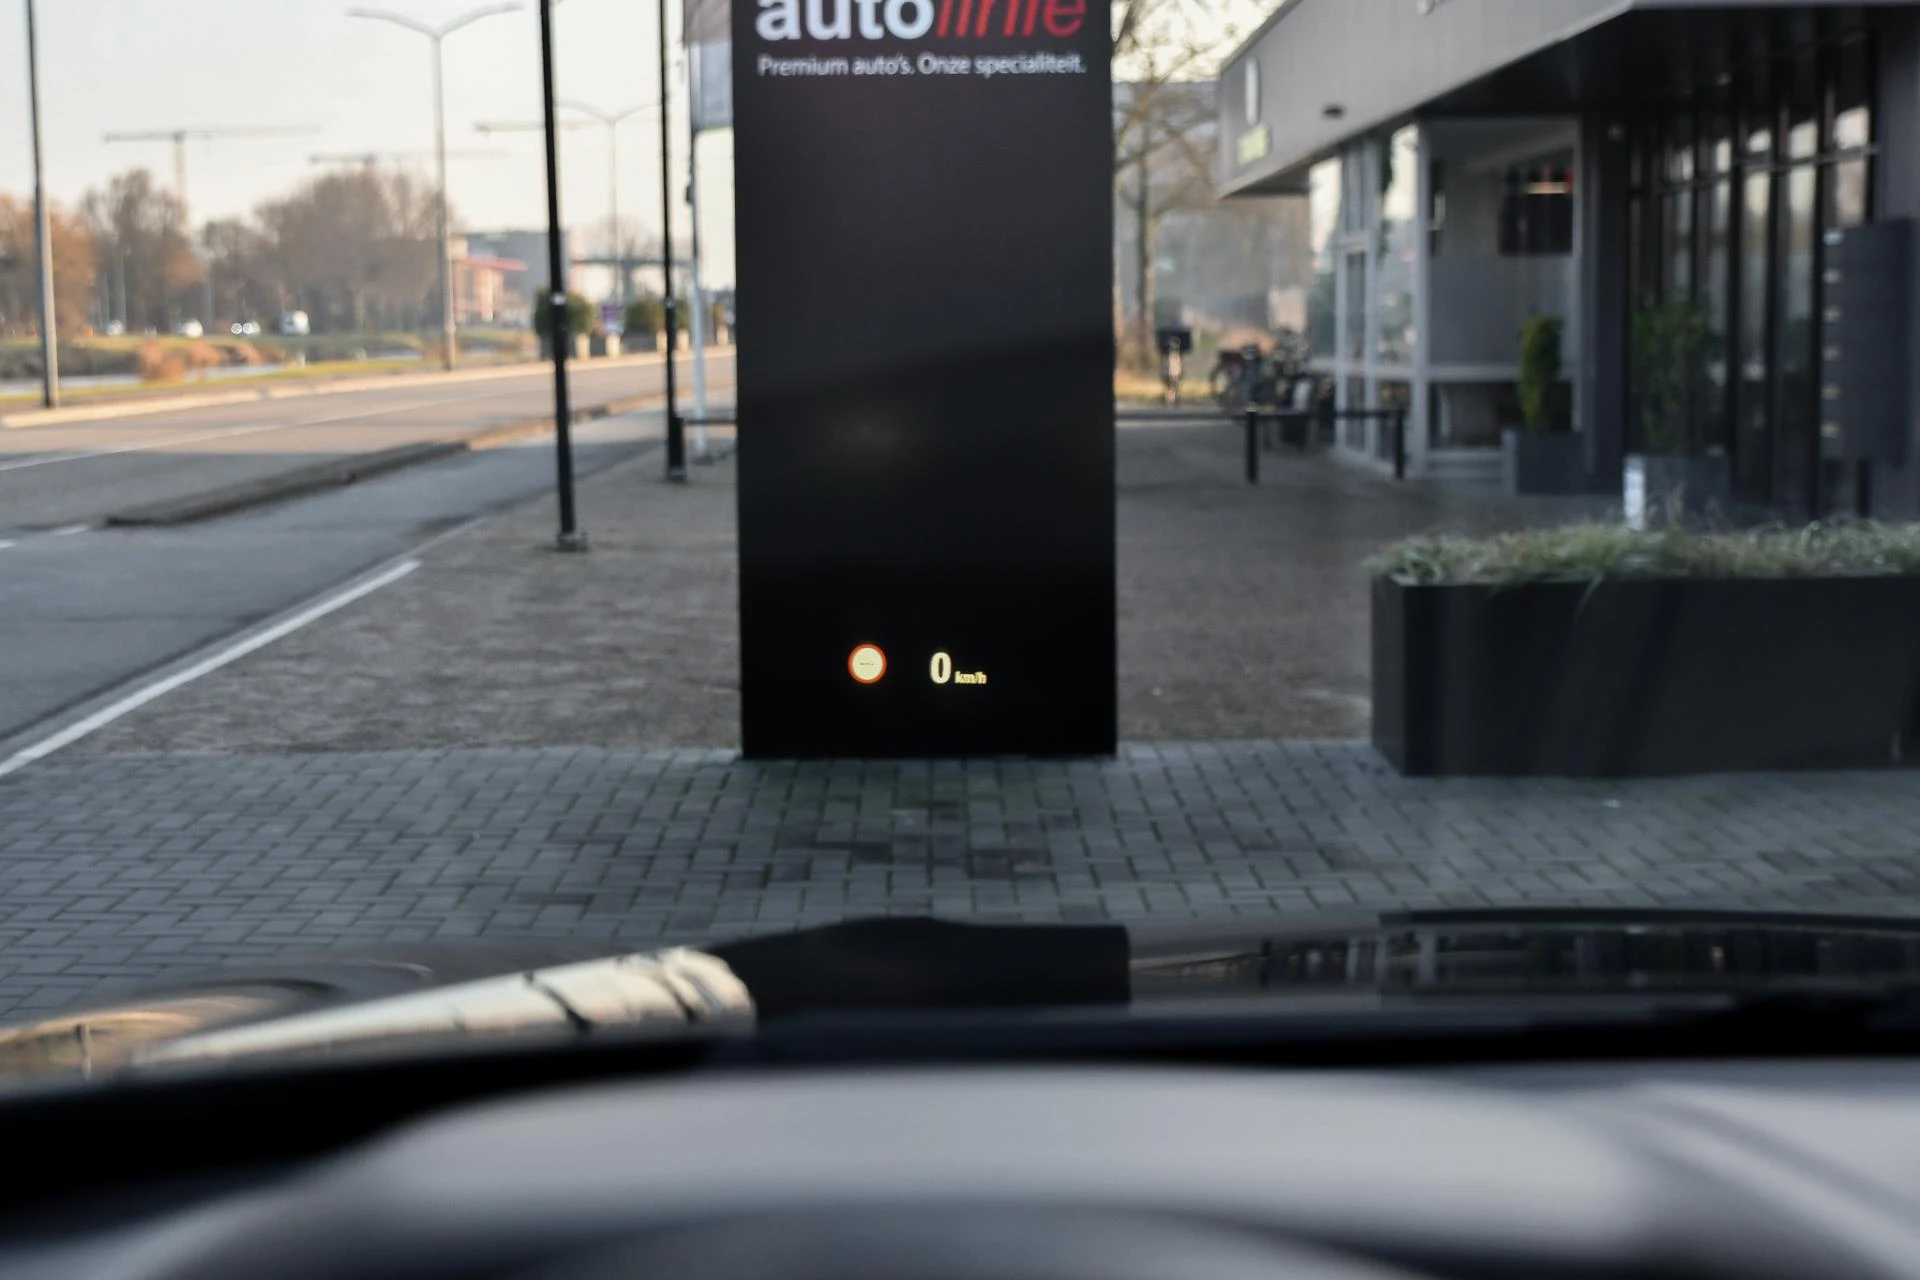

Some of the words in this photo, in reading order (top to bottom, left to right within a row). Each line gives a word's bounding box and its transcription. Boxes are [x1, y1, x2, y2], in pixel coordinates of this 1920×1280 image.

[757, 54, 849, 76] Premium
[852, 54, 916, 75] auto's.
[917, 51, 971, 75] Onze
[974, 51, 1087, 78] specialiteit.
[930, 651, 952, 684] 0
[954, 670, 988, 685] km/h
